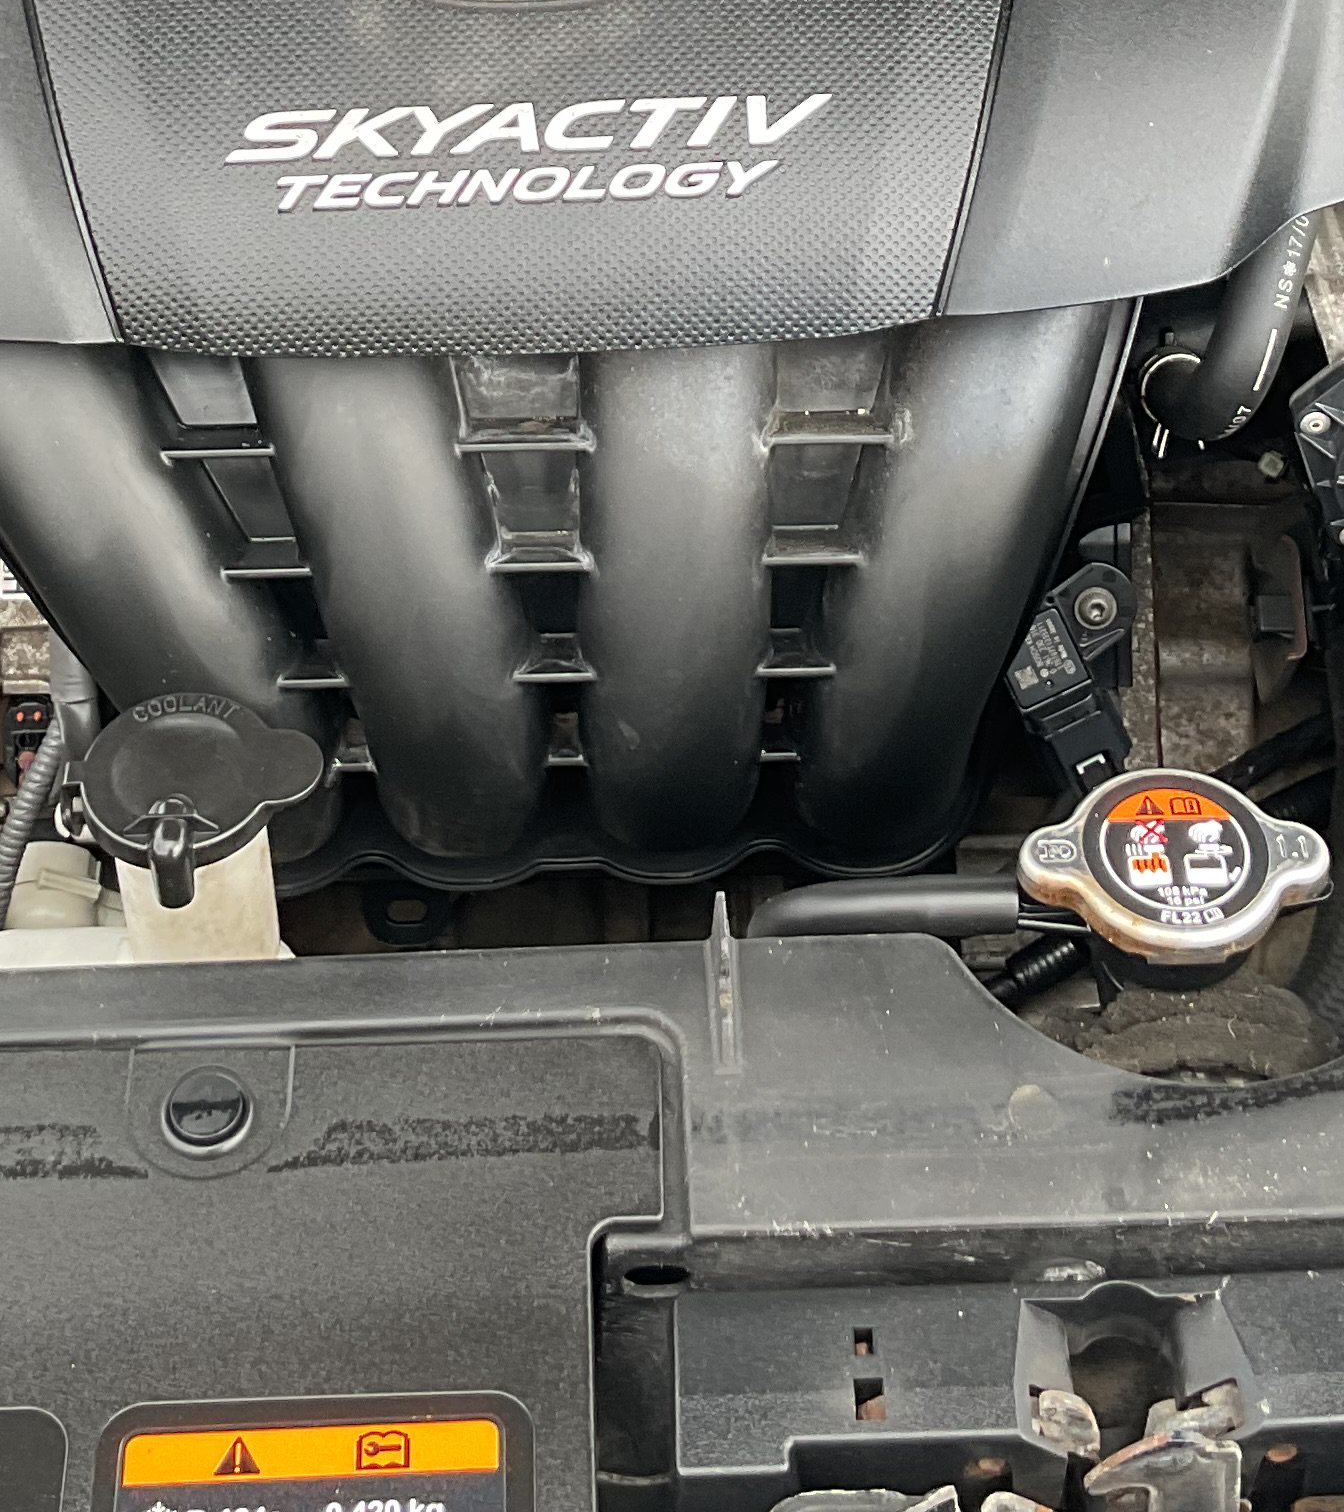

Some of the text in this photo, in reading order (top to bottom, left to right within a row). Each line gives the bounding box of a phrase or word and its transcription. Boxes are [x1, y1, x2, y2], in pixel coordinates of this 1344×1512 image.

[224, 93, 833, 165] SKYACTIV
[276, 159, 782, 214] TECHNOLOGY
[132, 695, 241, 723] COOLANT
[1184, 894, 1206, 907] psi
[1160, 909, 1203, 925] FL22
